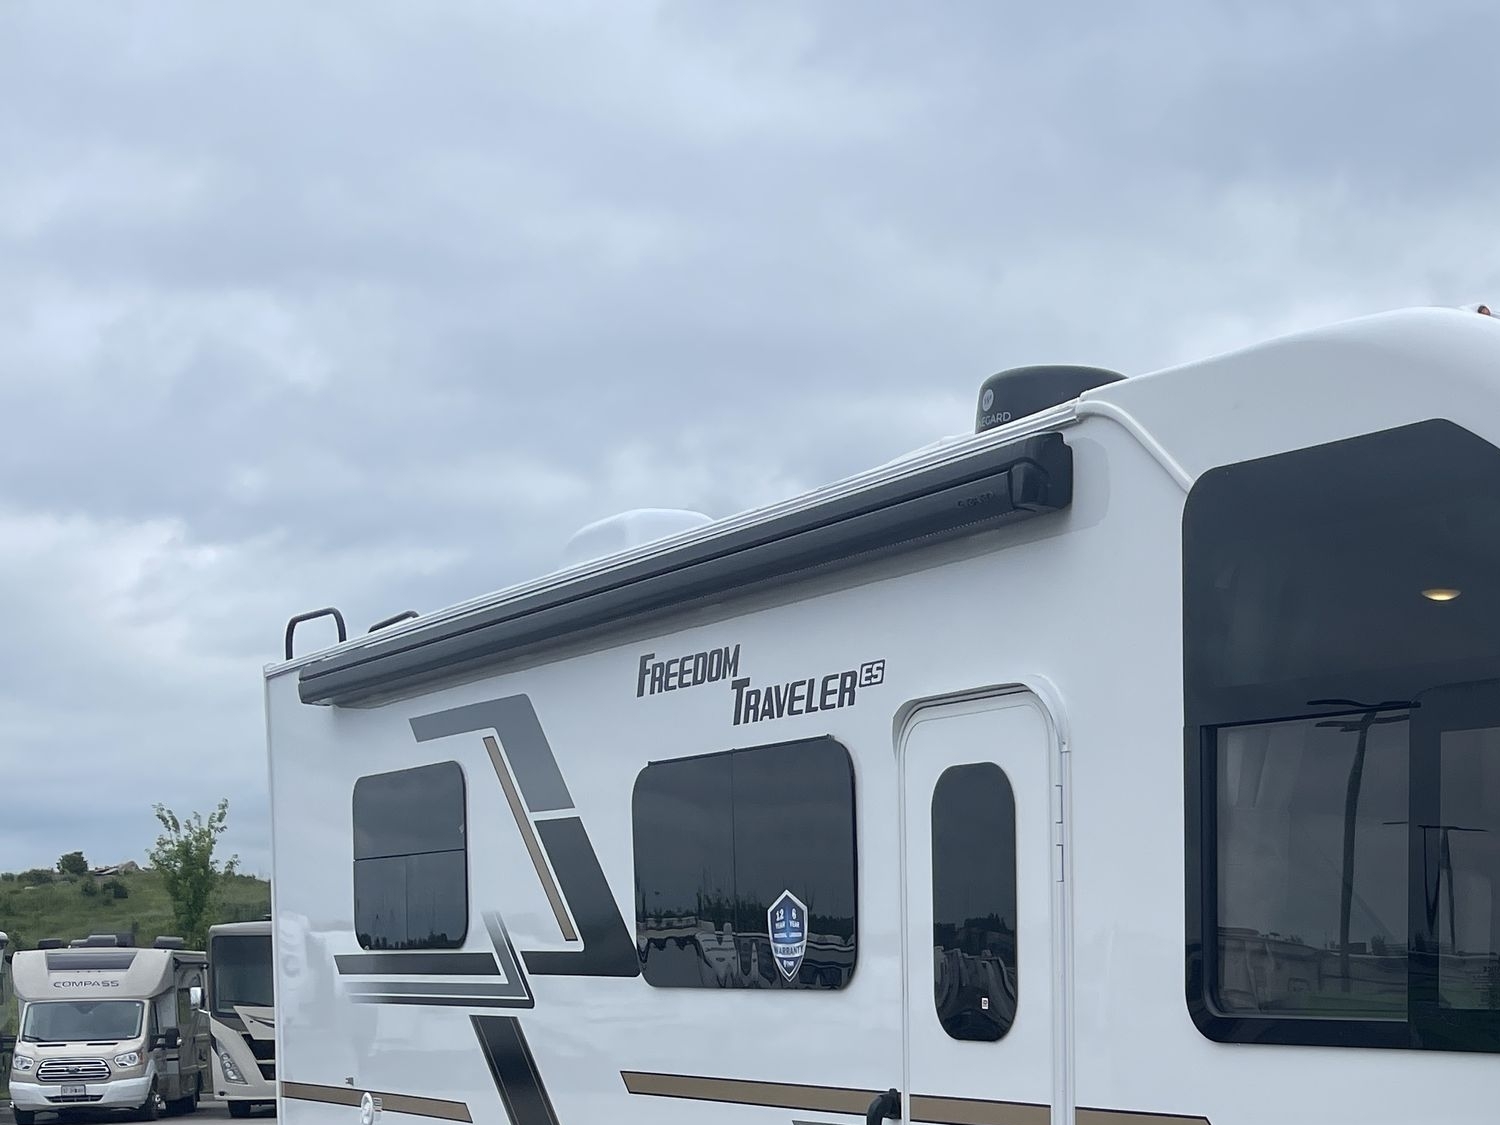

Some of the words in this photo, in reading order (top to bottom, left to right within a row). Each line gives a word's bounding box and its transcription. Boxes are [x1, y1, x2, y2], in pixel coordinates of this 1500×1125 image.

[636, 644, 741, 698] FREEDOM
[730, 670, 858, 726] TRAVELER
[859, 659, 886, 688] ES
[53, 980, 120, 988] COMPASS
